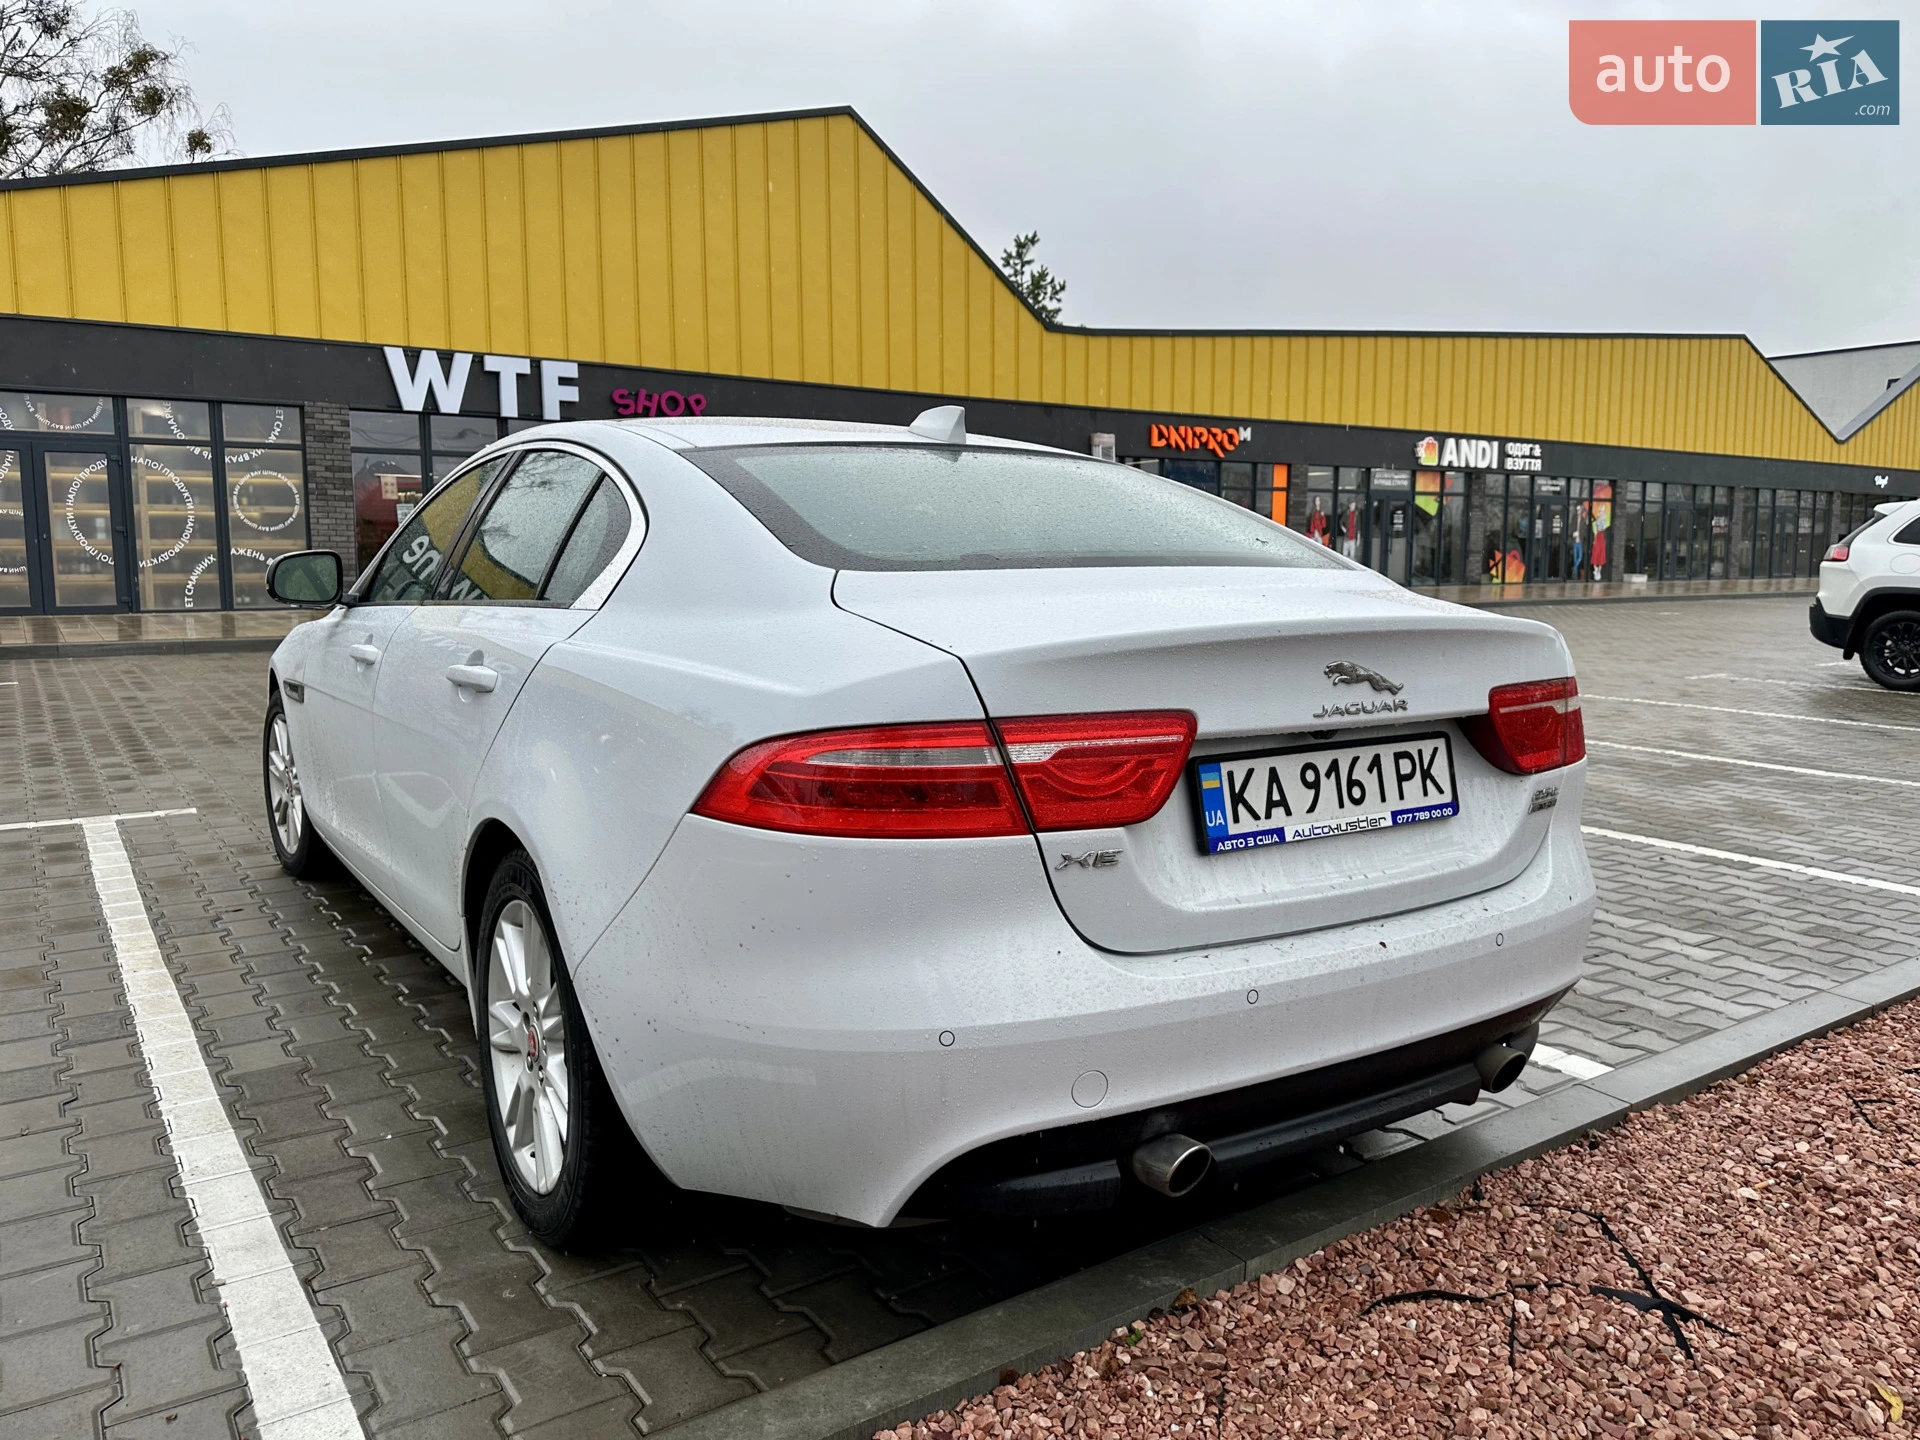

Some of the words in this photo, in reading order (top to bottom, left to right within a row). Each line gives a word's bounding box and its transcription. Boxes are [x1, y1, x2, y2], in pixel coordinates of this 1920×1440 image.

[383, 345, 580, 421] WTF
[612, 388, 708, 418] SHOP
[1151, 423, 1240, 458] DNIPRO
[1239, 426, 1252, 441] M
[1440, 437, 1499, 469] ANDI
[131, 455, 164, 471] НАПОЇ
[1504, 457, 1542, 471] ВЗУТТЯ
[66, 477, 83, 506] НАПОЇ
[162, 467, 194, 510] ПРОДУКТИ
[66, 512, 98, 556] ПРОДУКТИ
[182, 515, 195, 544] НАПОЇ
[139, 541, 184, 568] ПРОДУКТИ
[185, 554, 217, 596] СМАЧНИХ
[1313, 699, 1409, 718] JAGUAR
[1227, 766, 1293, 824] KA
[1300, 753, 1387, 814] 9161
[1393, 747, 1445, 801] PK
[1205, 810, 1225, 827] UA
[1396, 813, 1412, 823] 077
[1415, 811, 1430, 821] 789
[1431, 809, 1442, 818] 00
[1442, 807, 1453, 816] 00
[1216, 839, 1246, 852] АВТО
[1256, 834, 1280, 845] США
[1054, 849, 1124, 870] XE
